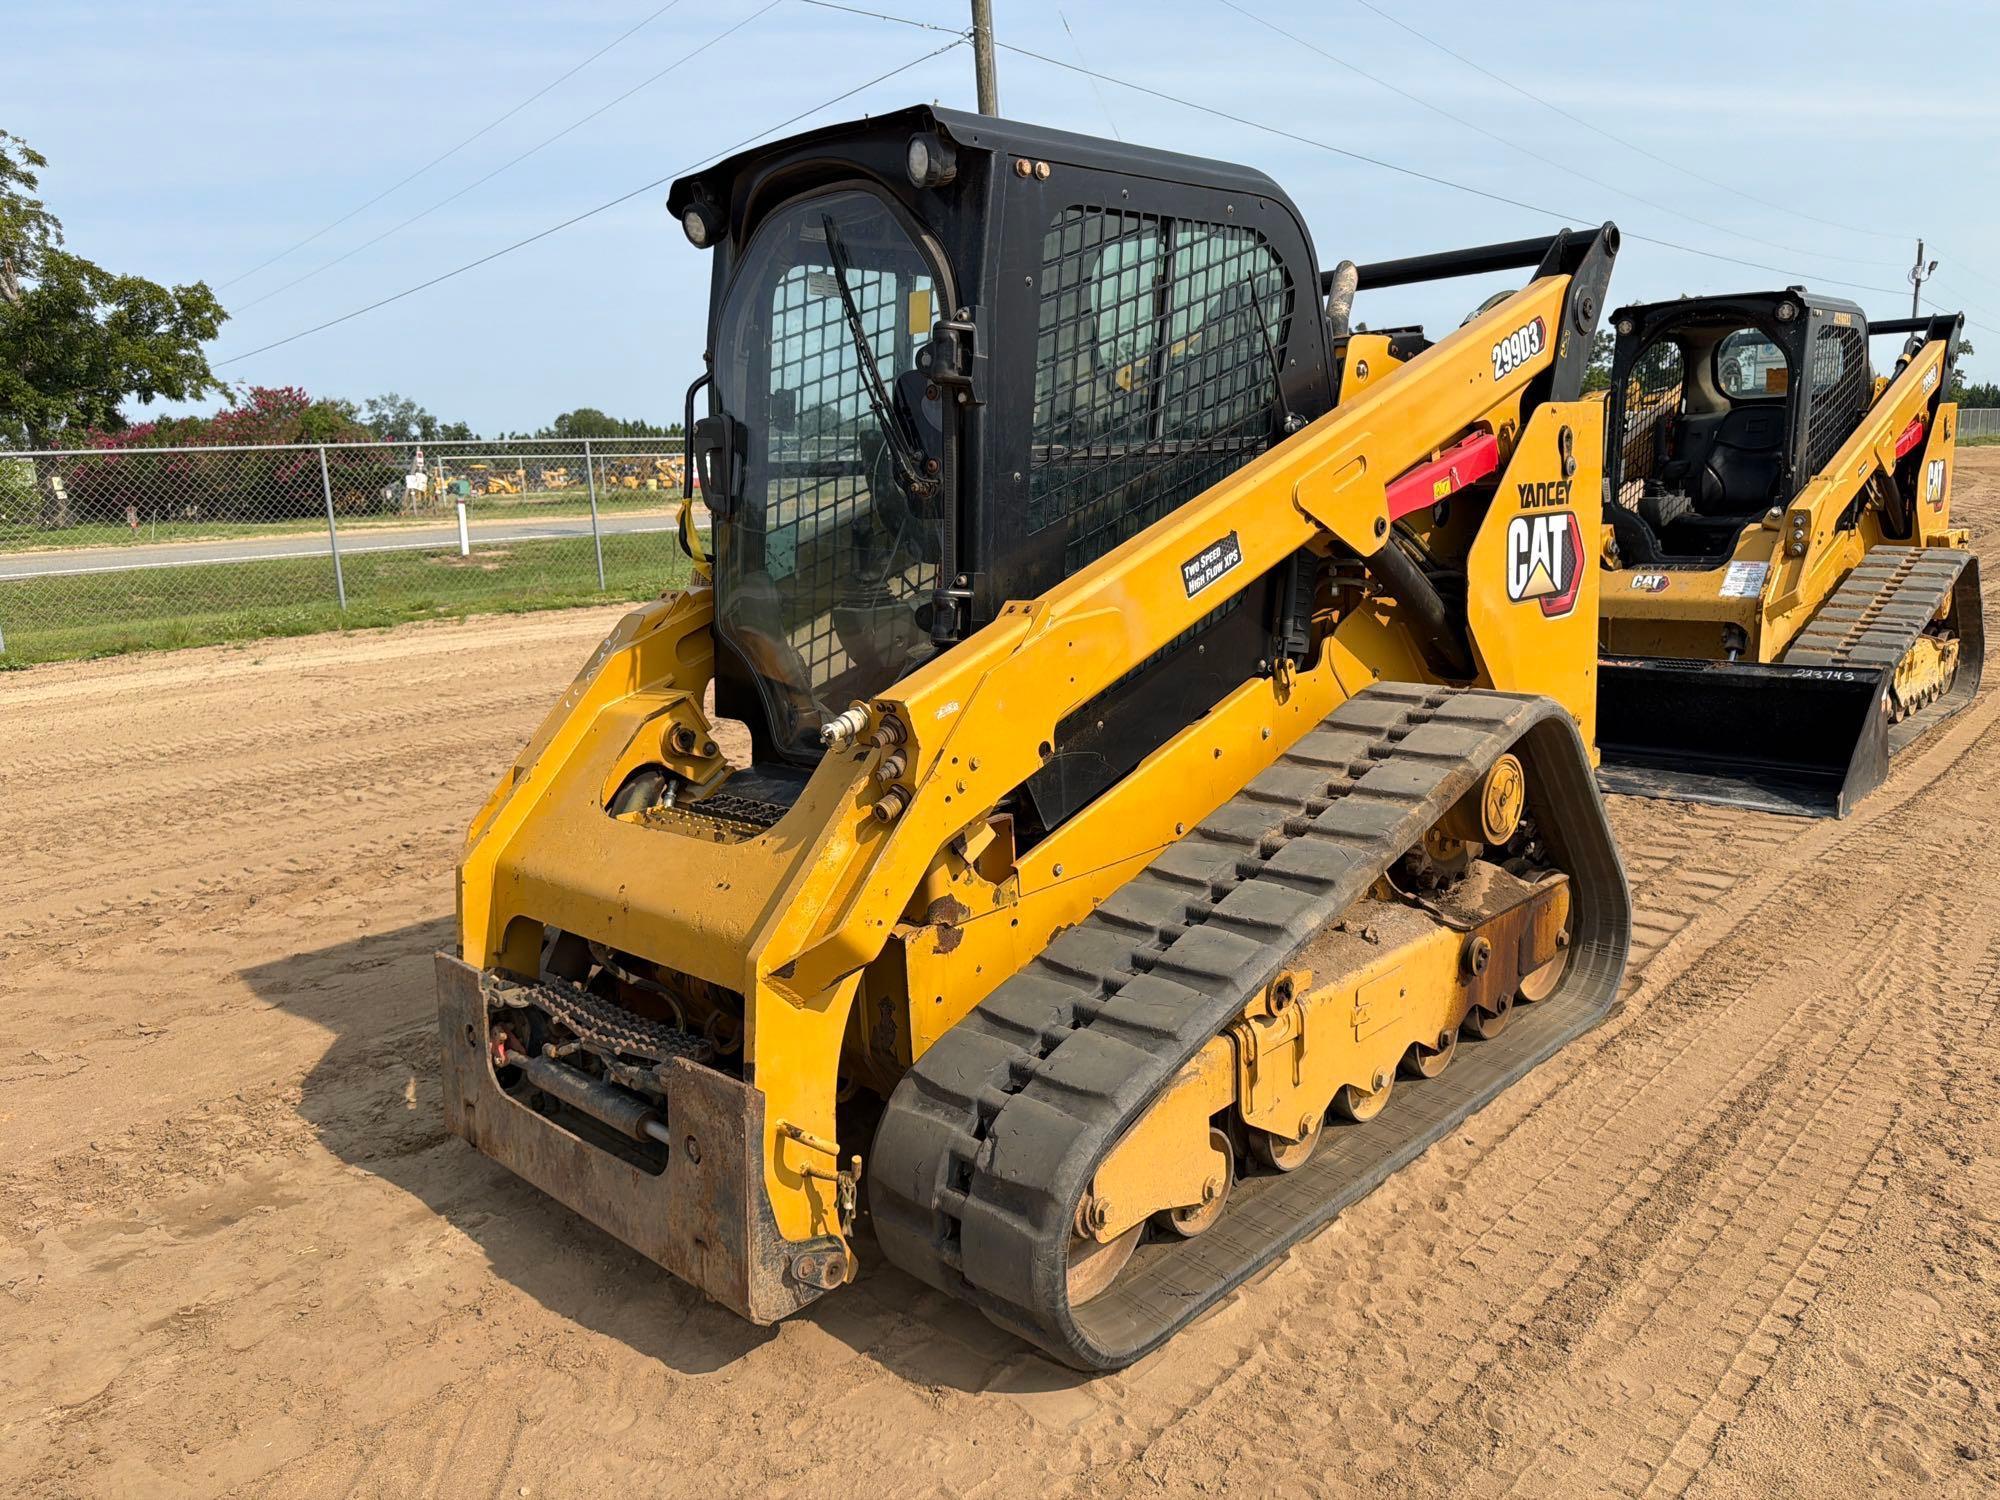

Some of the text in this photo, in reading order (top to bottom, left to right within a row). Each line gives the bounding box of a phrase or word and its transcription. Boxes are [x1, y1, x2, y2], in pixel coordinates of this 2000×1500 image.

[1492, 321, 1540, 380] 299D3
[1517, 480, 1572, 509] YANCEY
[1926, 460, 1945, 502] CAT
[1223, 549, 1238, 568] XPS
[1508, 514, 1568, 600] CAT
[1631, 575, 1662, 589] CAT
[1791, 668, 1855, 681] 223743
